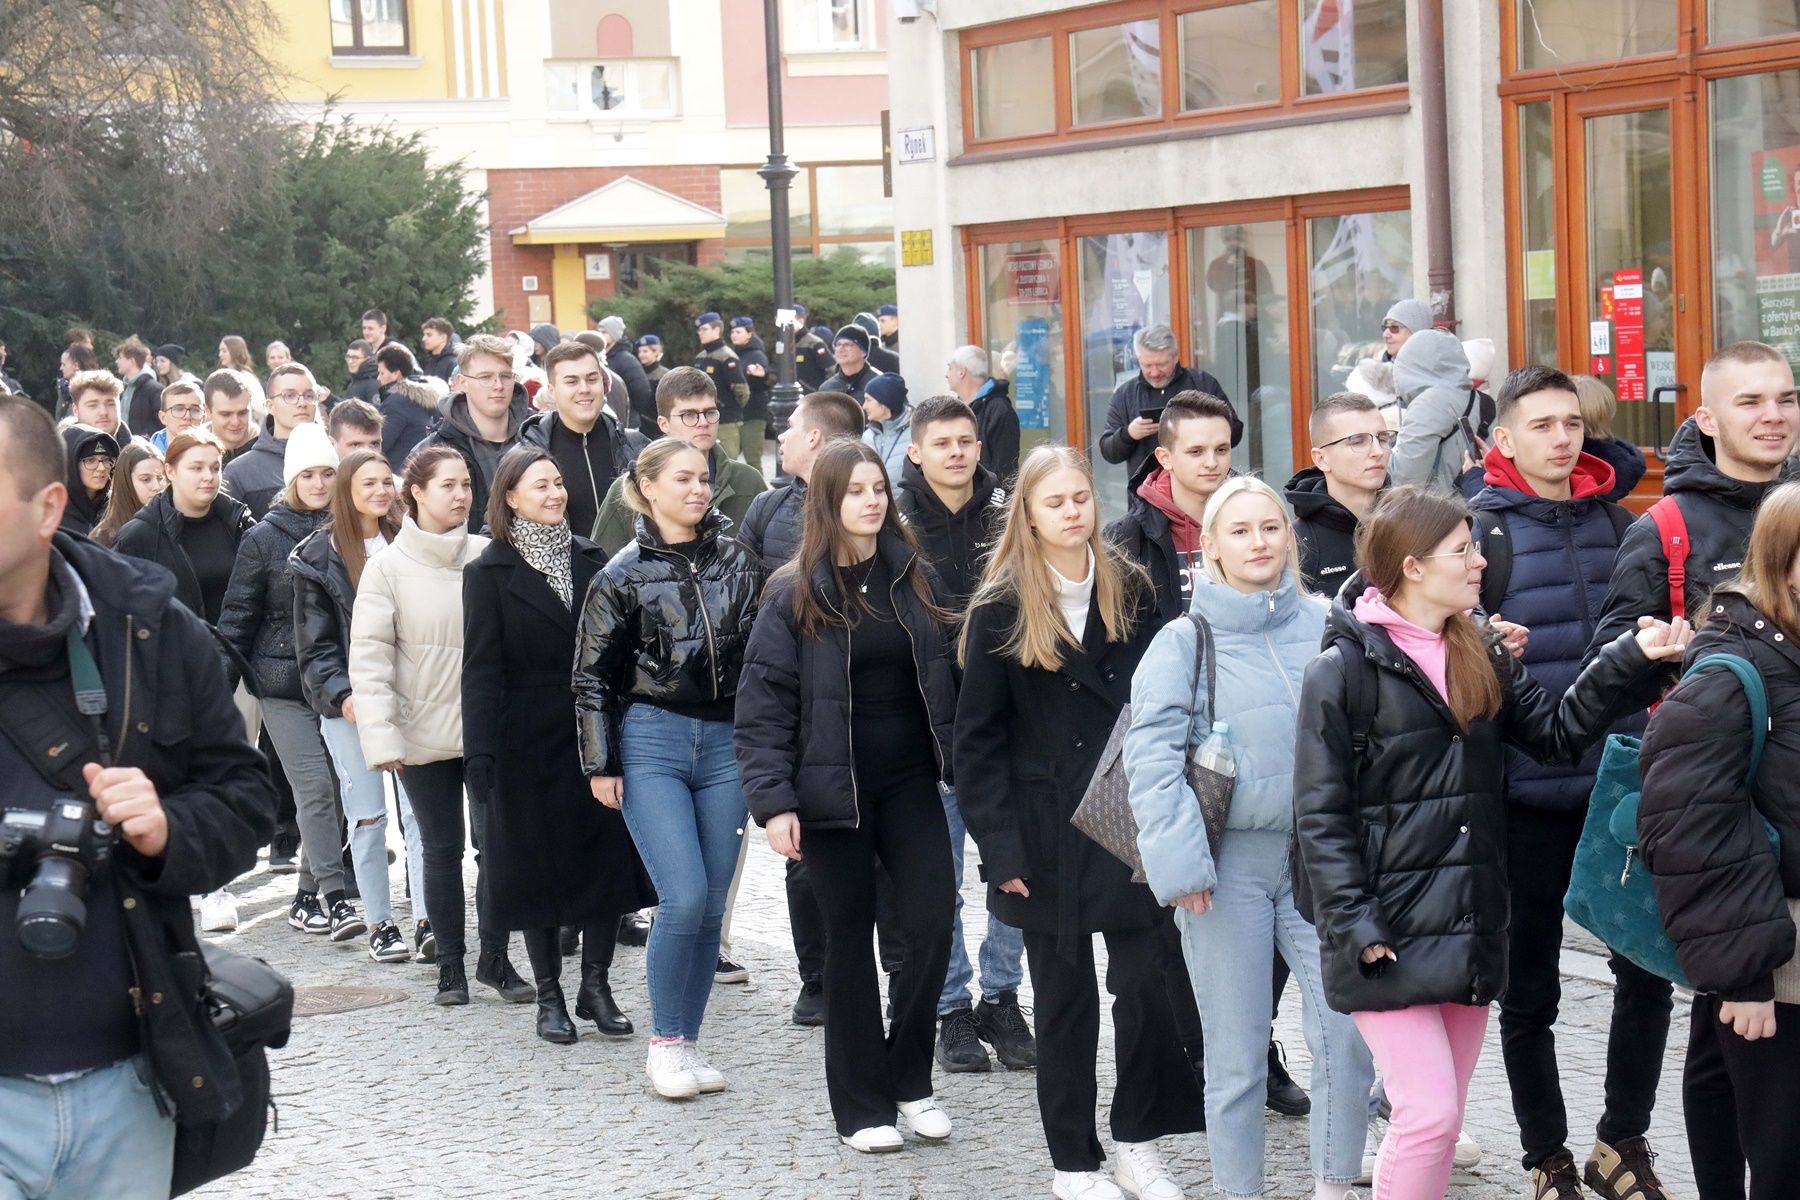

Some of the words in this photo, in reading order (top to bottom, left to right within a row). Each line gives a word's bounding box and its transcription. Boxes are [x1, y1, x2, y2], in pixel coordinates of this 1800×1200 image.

[905, 133, 926, 158] Rynek
[1761, 296, 1795, 309] Skorzystaj
[1762, 314, 1767, 323] z
[1767, 310, 1789, 323] oferty
[1762, 328, 1770, 337] w
[1770, 323, 1793, 337] Banku
[1320, 565, 1347, 575] ellesse
[1713, 562, 1741, 571] ellesse
